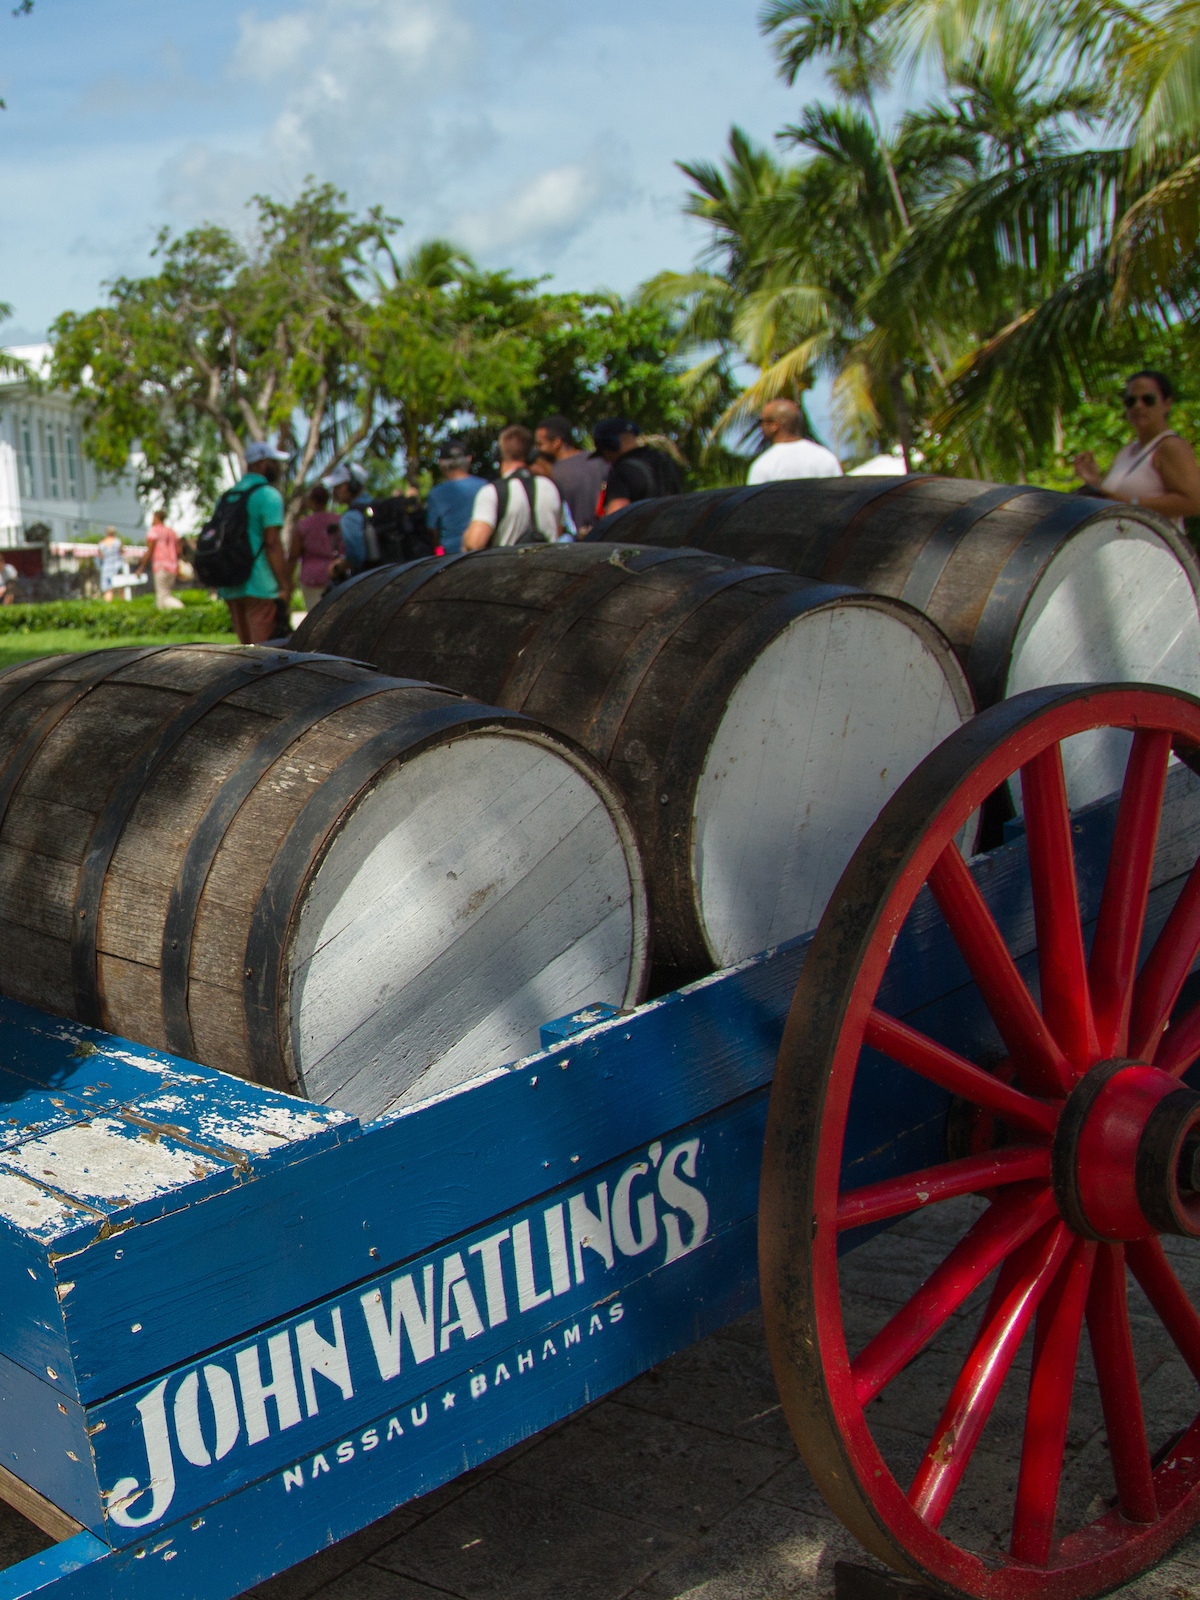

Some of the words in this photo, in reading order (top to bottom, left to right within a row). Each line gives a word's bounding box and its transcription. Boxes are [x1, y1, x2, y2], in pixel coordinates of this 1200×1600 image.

[106, 1307, 354, 1528] JOHN
[362, 1138, 709, 1381] WATLING'S
[283, 1402, 428, 1493] NASSAU
[470, 1303, 625, 1399] BAHAMAS
